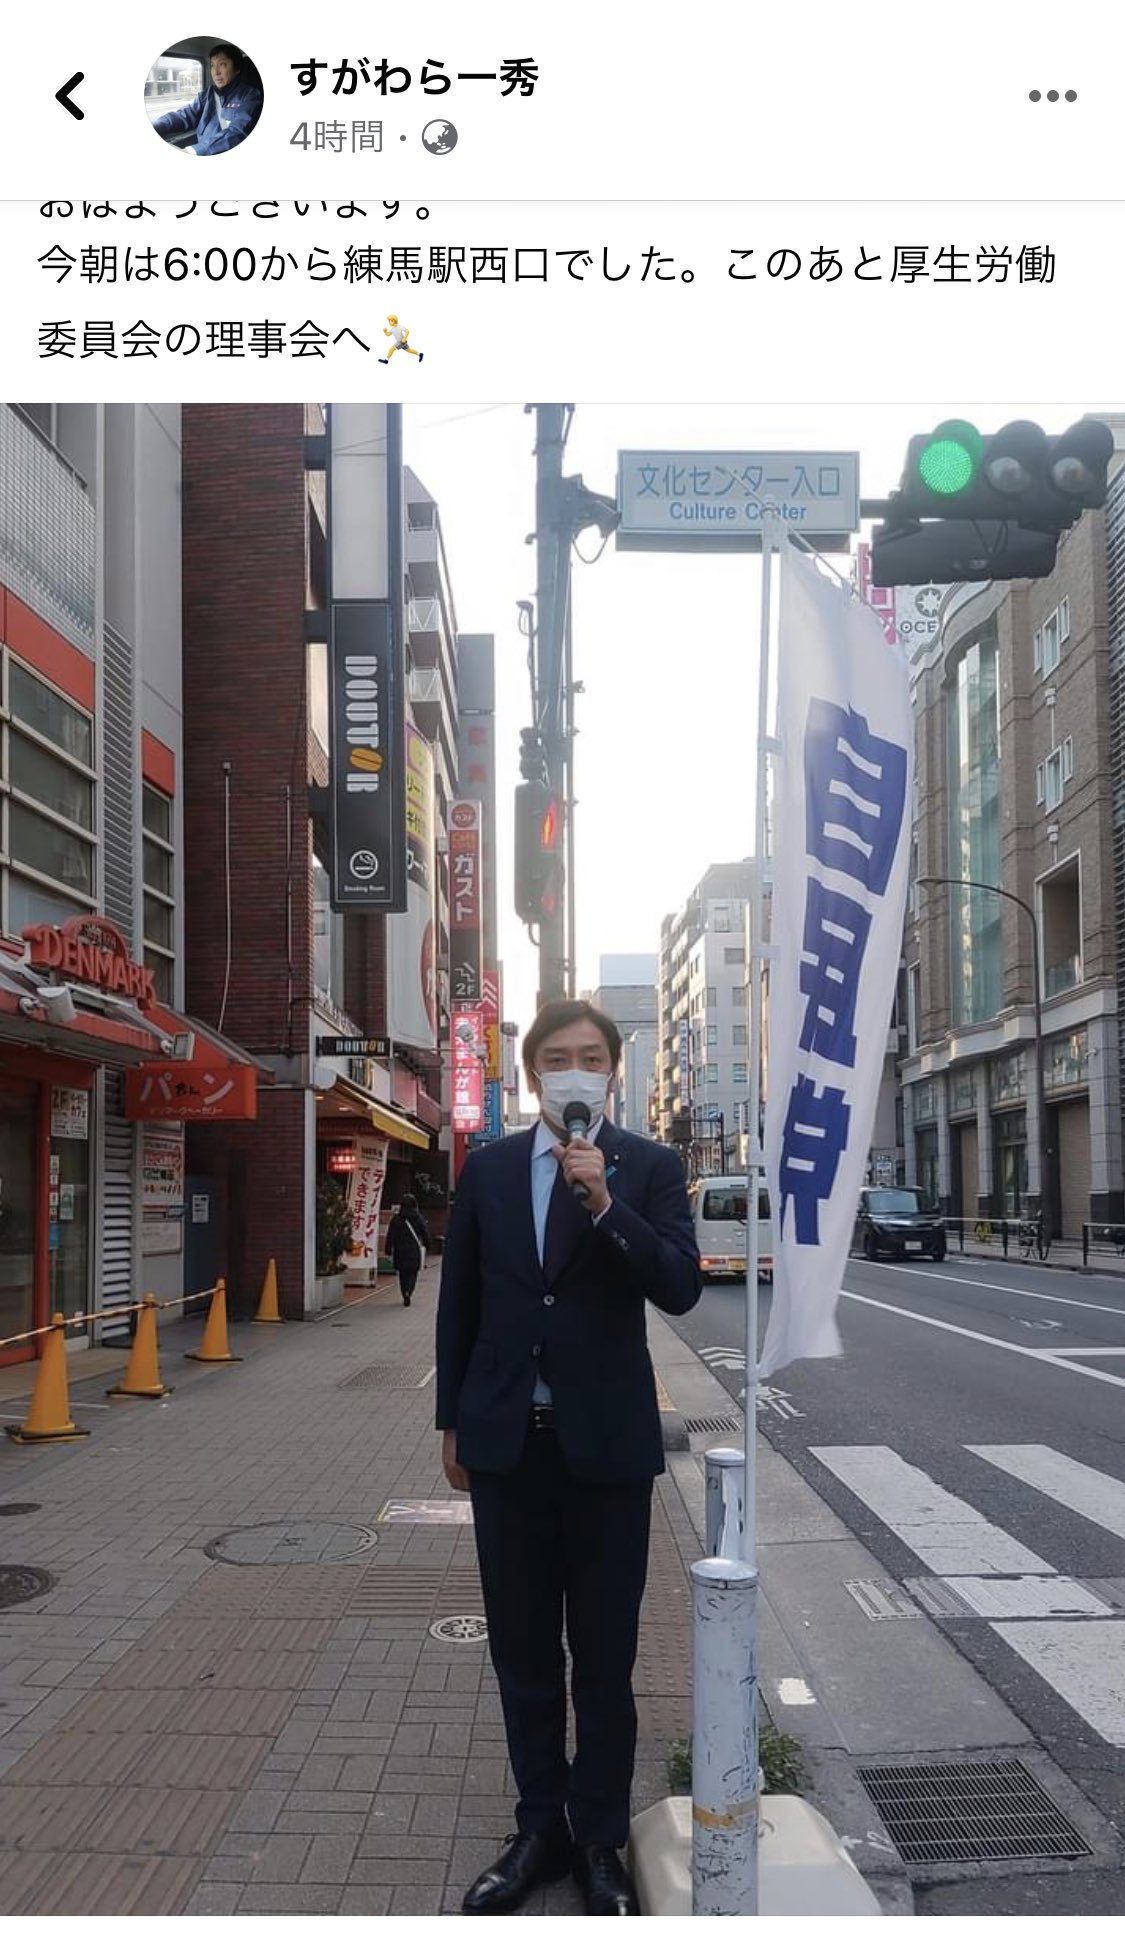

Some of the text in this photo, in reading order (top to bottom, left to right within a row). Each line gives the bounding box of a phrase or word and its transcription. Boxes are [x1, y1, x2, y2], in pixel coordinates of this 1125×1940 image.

[636, 464, 840, 497] 文化センター入口
[669, 501, 736, 520] Culture
[345, 656, 384, 793] DOUTOR
[453, 852, 474, 922] ガスト
[32, 926, 156, 1004] DENMARK
[456, 982, 475, 996] 2F
[140, 1071, 235, 1105] パン
[352, 1166, 371, 1231] できます
